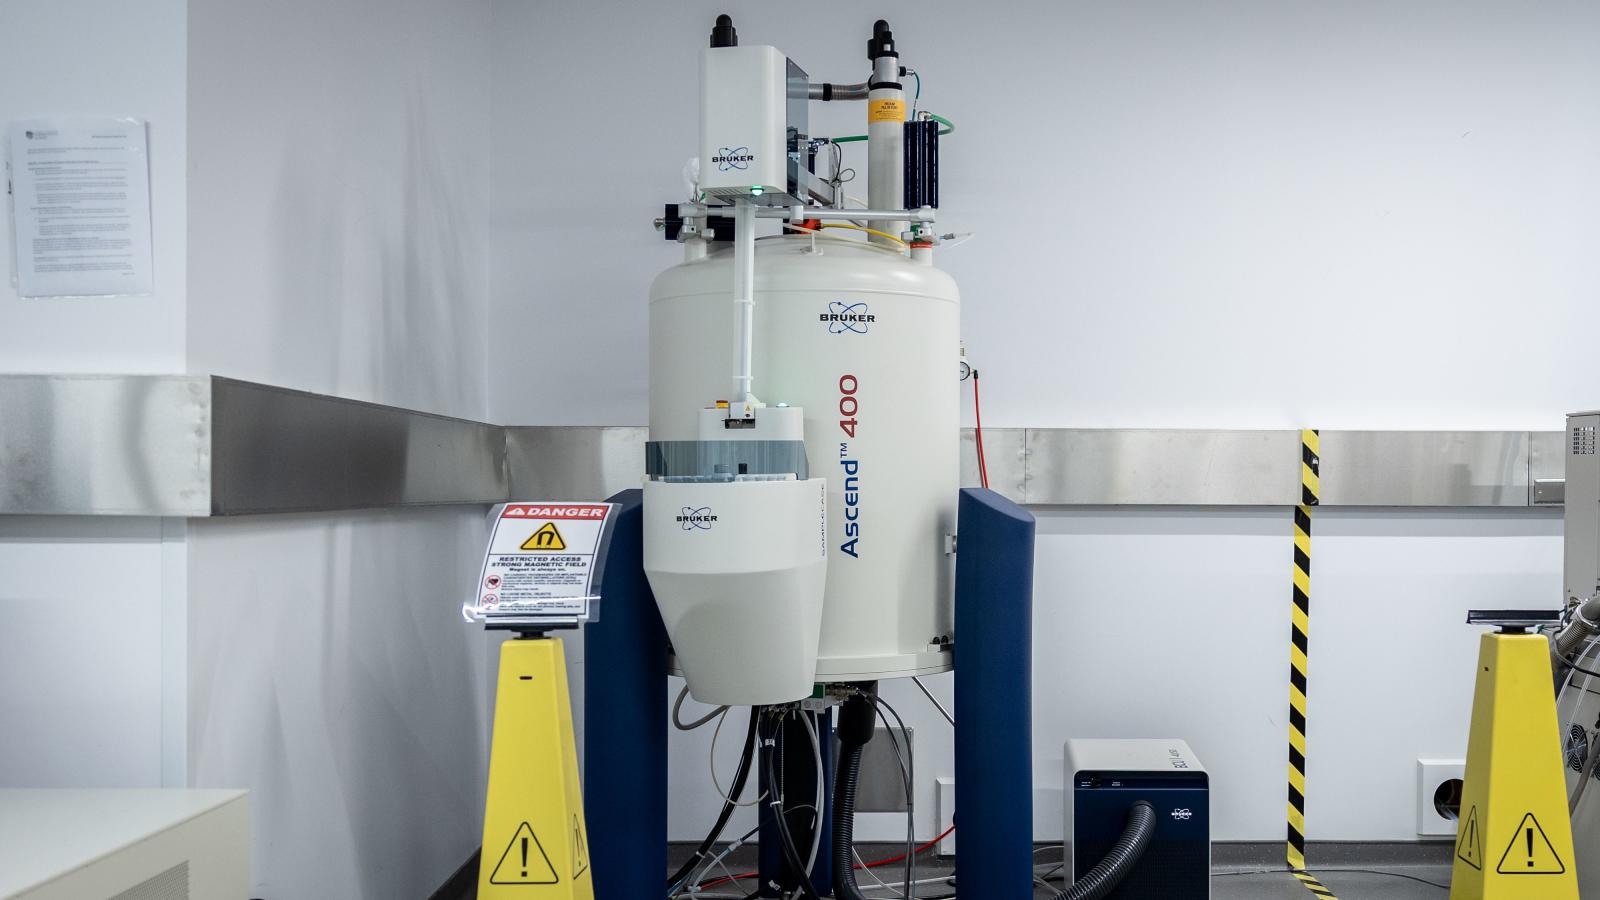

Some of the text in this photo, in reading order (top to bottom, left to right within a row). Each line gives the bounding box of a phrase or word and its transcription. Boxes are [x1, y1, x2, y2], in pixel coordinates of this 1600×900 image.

[712, 154, 754, 163] BRUKER
[820, 312, 875, 323] BRUKER
[839, 374, 858, 438] 400
[527, 507, 603, 517] DANGER
[676, 514, 718, 523] BRUKER
